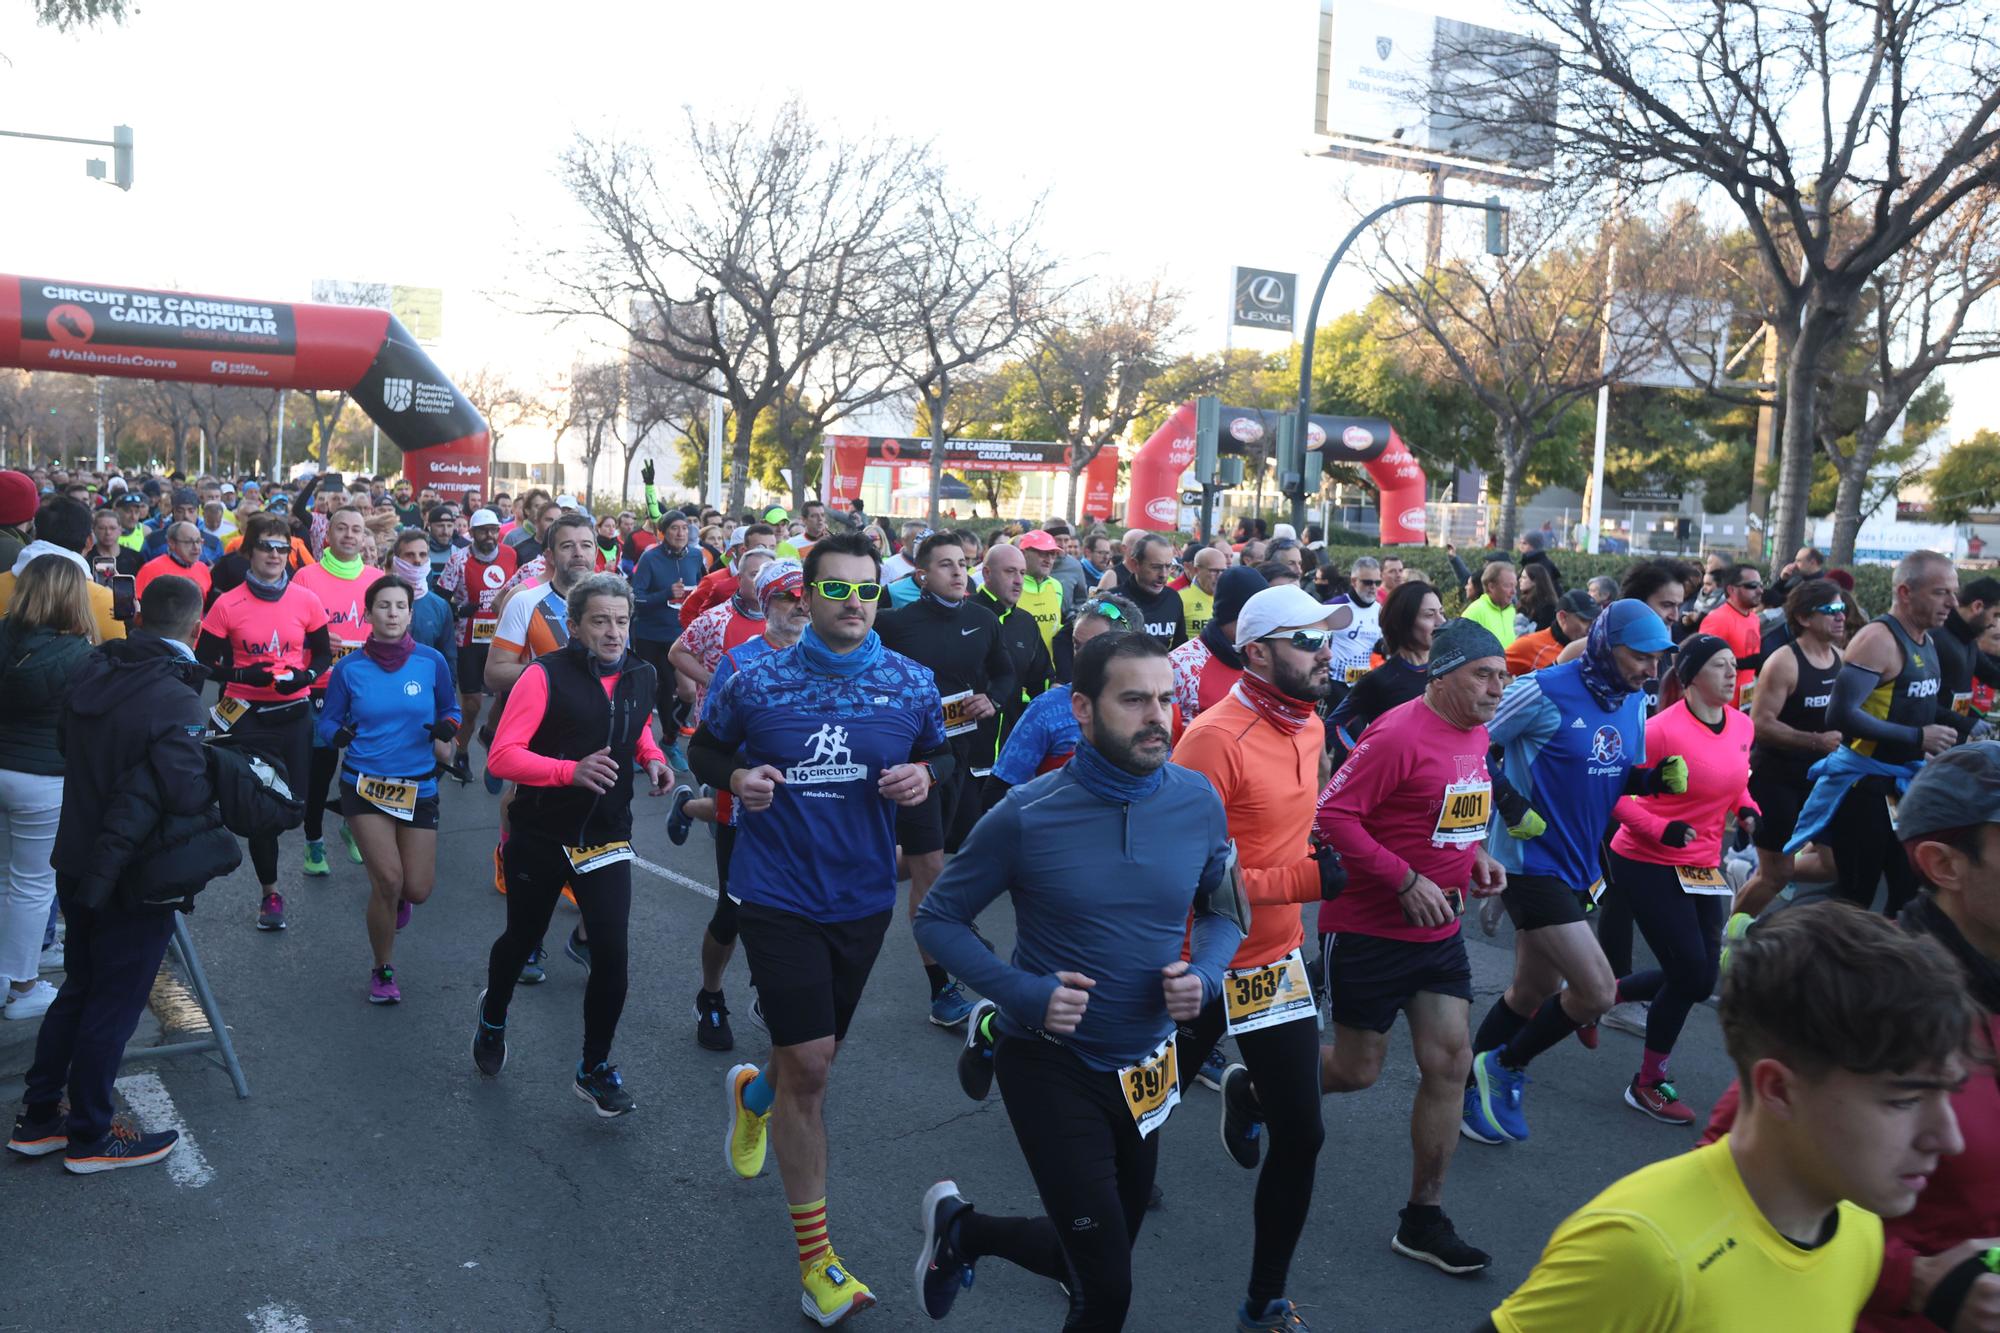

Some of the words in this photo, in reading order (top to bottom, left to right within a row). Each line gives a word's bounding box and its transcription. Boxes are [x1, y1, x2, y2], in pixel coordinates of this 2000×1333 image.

[42, 285, 127, 305] CIRCUIT
[132, 294, 161, 310] DE
[164, 297, 274, 320] CARRERES
[1239, 310, 1291, 324] LEXUS
[48, 347, 177, 369] #ValènciaCorre
[955, 442, 967, 450] DE
[967, 442, 1012, 452] CARRERES
[792, 769, 809, 782] 16
[809, 766, 859, 777] CIRCUITO
[365, 781, 407, 803] 4022
[802, 790, 845, 800] #MadeToRun
[1451, 793, 1483, 819] 4001
